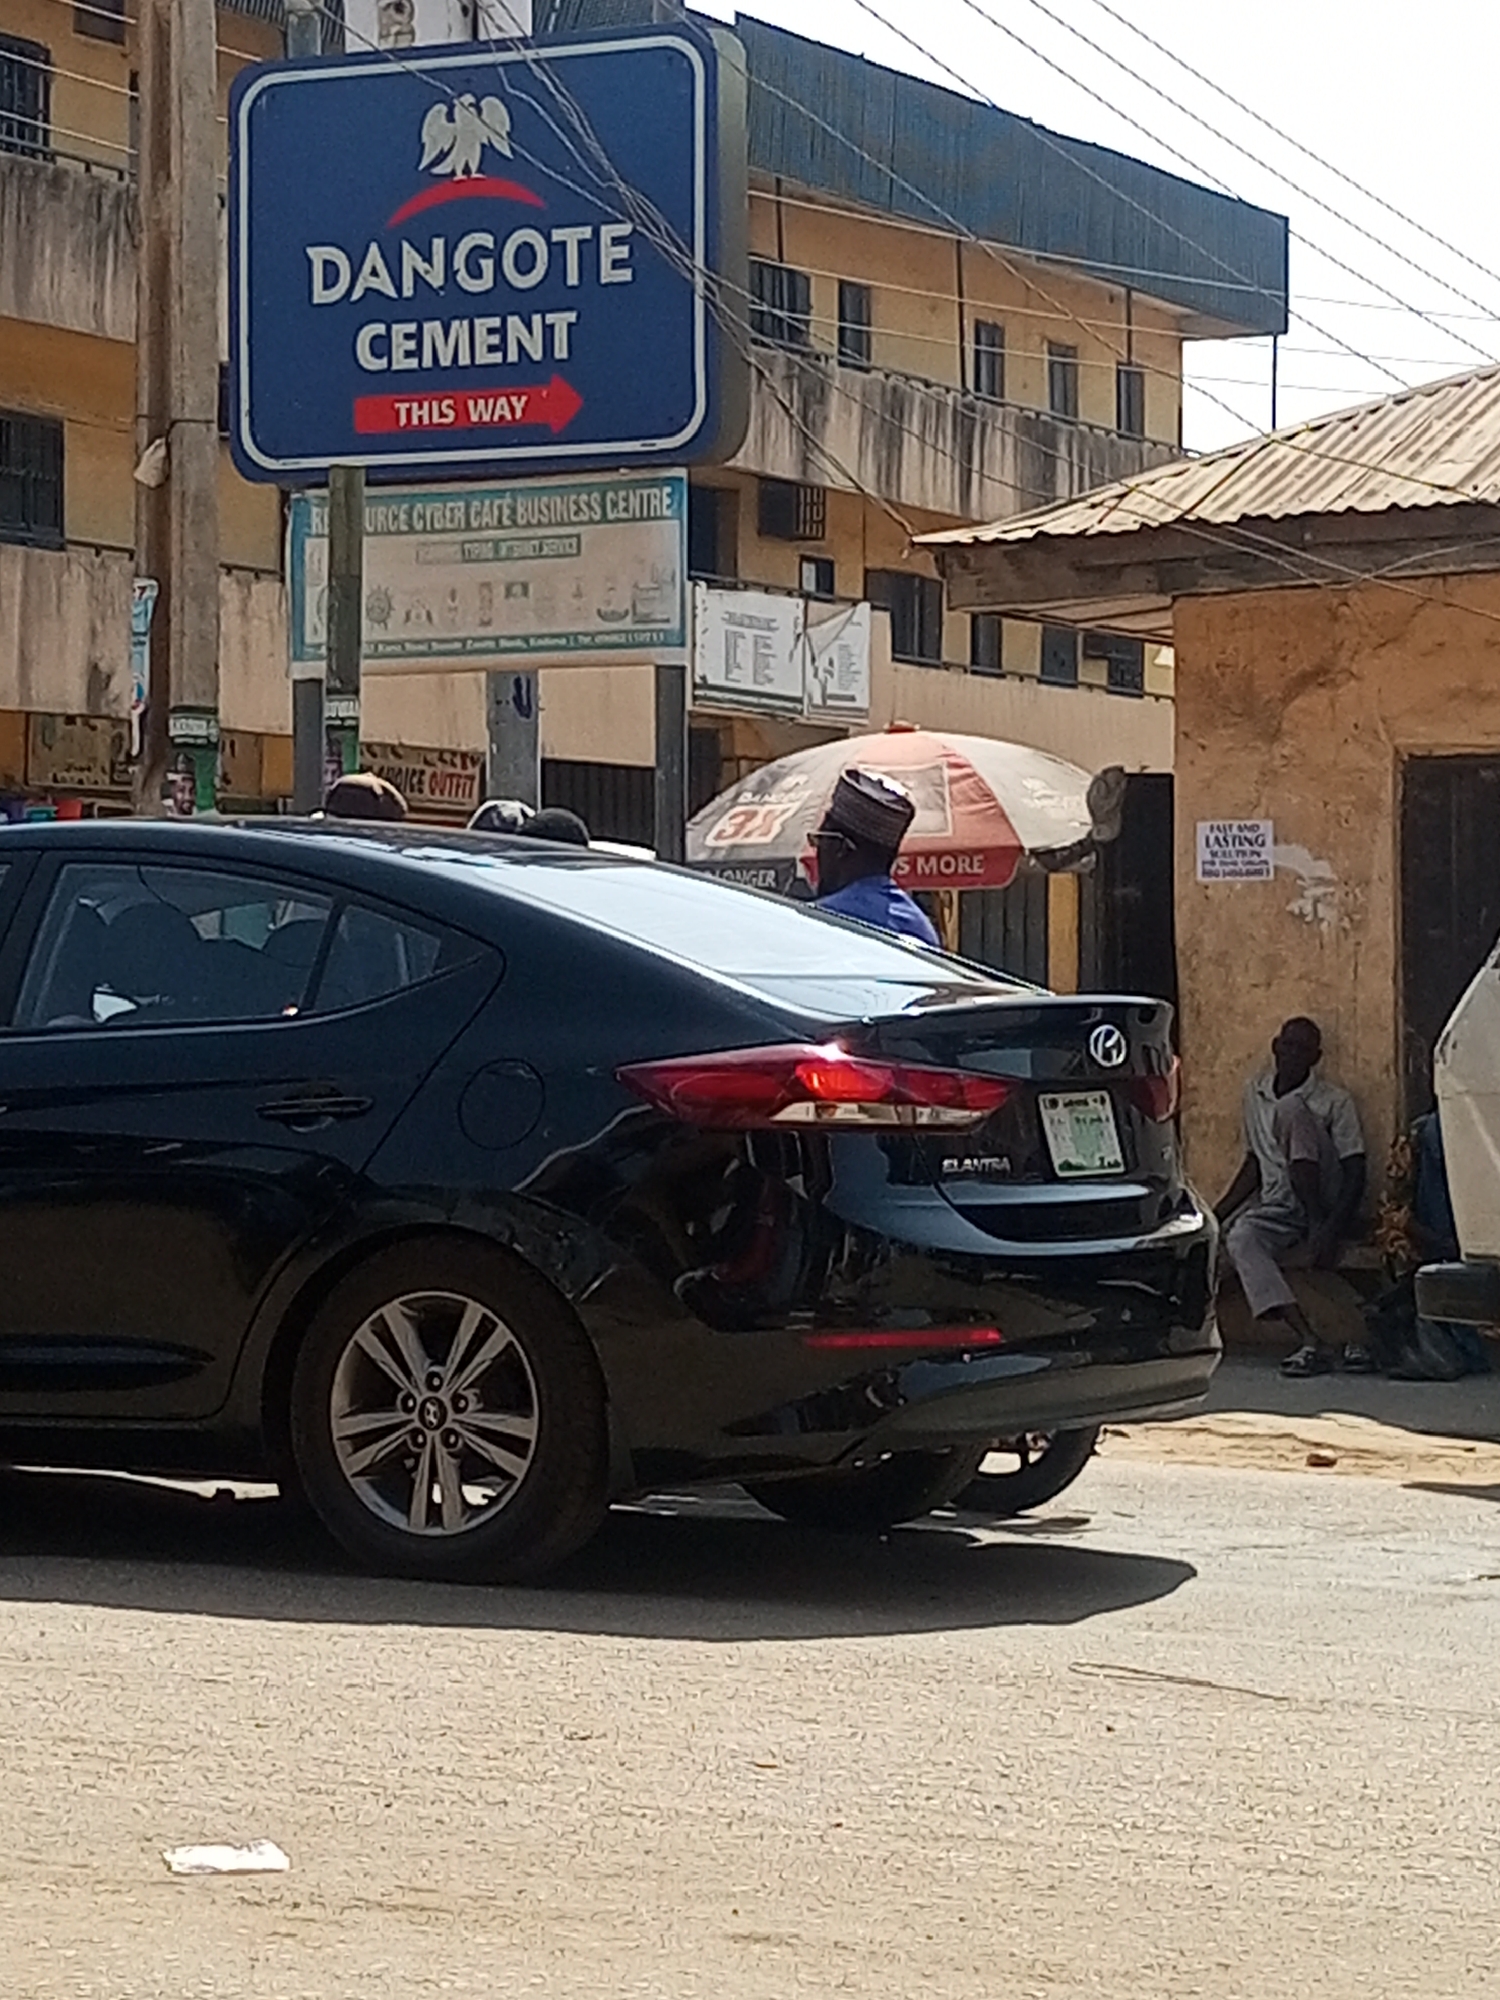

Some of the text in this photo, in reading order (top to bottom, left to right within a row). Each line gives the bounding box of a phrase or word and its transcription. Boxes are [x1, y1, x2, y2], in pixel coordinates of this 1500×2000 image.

[306, 224, 634, 304] DANGOTE
[355, 311, 577, 371] CEMENT
[395, 395, 528, 426] THIS WAY
[412, 502, 465, 531] CYBER
[517, 493, 600, 526] BUSINESS
[606, 486, 672, 519] CENTRE
[429, 770, 476, 799] OUTFIT
[1205, 834, 1267, 849] LASTING
[916, 854, 985, 876] MORE
[942, 1157, 1011, 1173] ELANTRA
